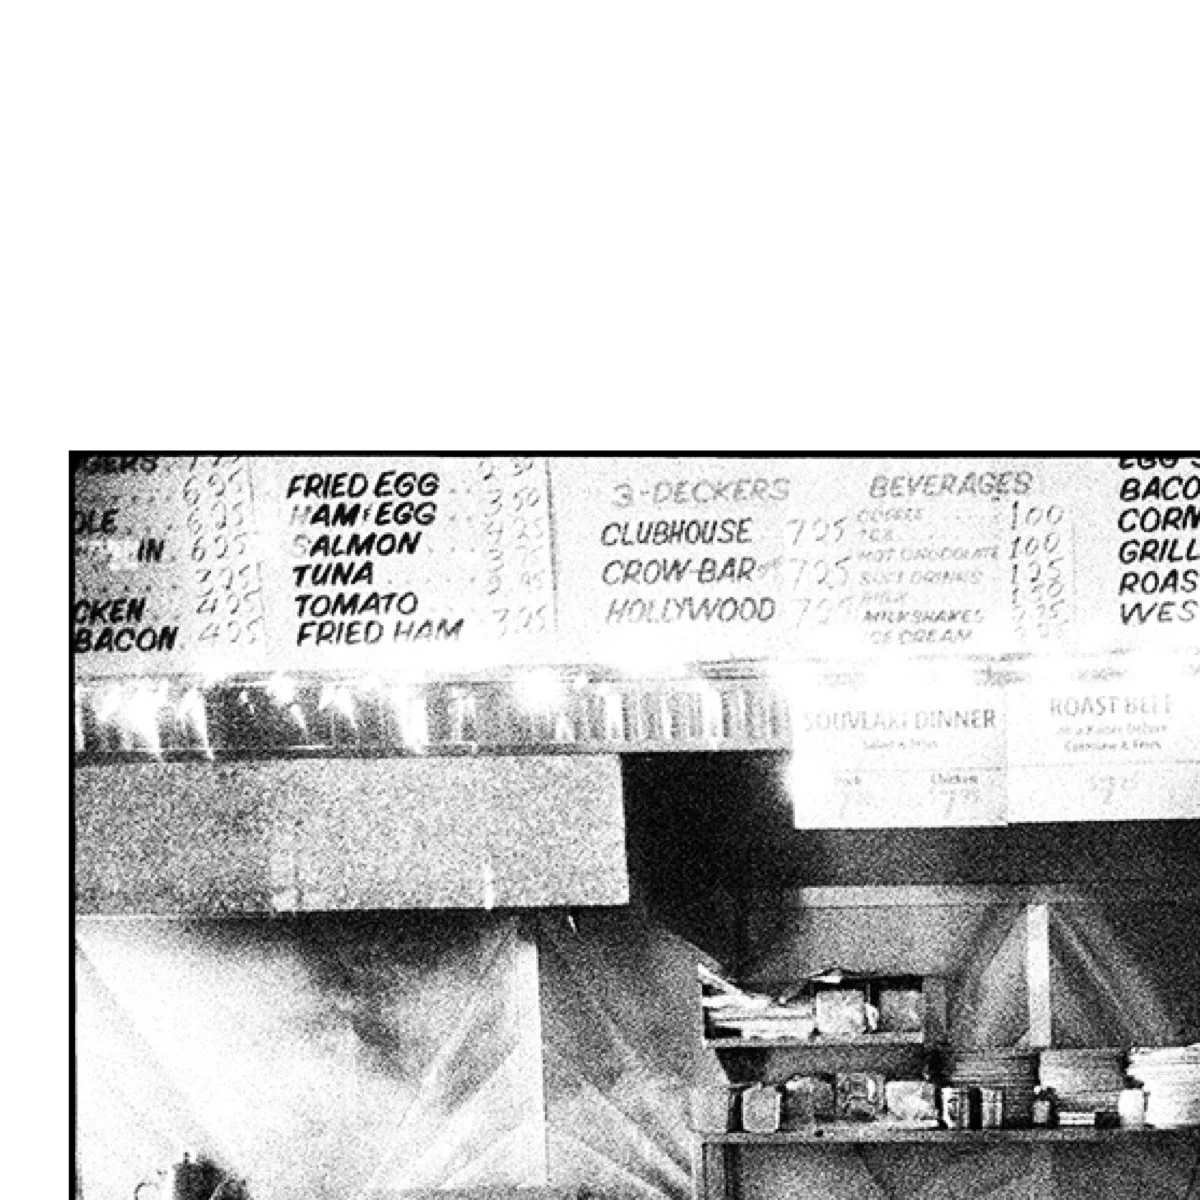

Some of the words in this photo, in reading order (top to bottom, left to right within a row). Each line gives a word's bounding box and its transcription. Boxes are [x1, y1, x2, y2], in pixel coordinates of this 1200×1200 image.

[287, 472, 369, 498] FRIED
[374, 470, 440, 497] EGG
[612, 477, 791, 508] 3-DECKERS
[869, 470, 1033, 499] BEVERAGES
[375, 502, 437, 526] EGG
[600, 516, 752, 546] CLUBHOUSE
[293, 560, 374, 588] TUNA
[601, 557, 756, 585] CROW-BAR
[295, 592, 419, 618] TOMATO
[605, 596, 776, 624] HOLLYWOOD
[75, 625, 178, 652] BACON
[297, 620, 384, 647] FRIED
[394, 618, 465, 642] HAM
[914, 708, 996, 730] DINNER
[1049, 695, 1119, 717] ROAST
